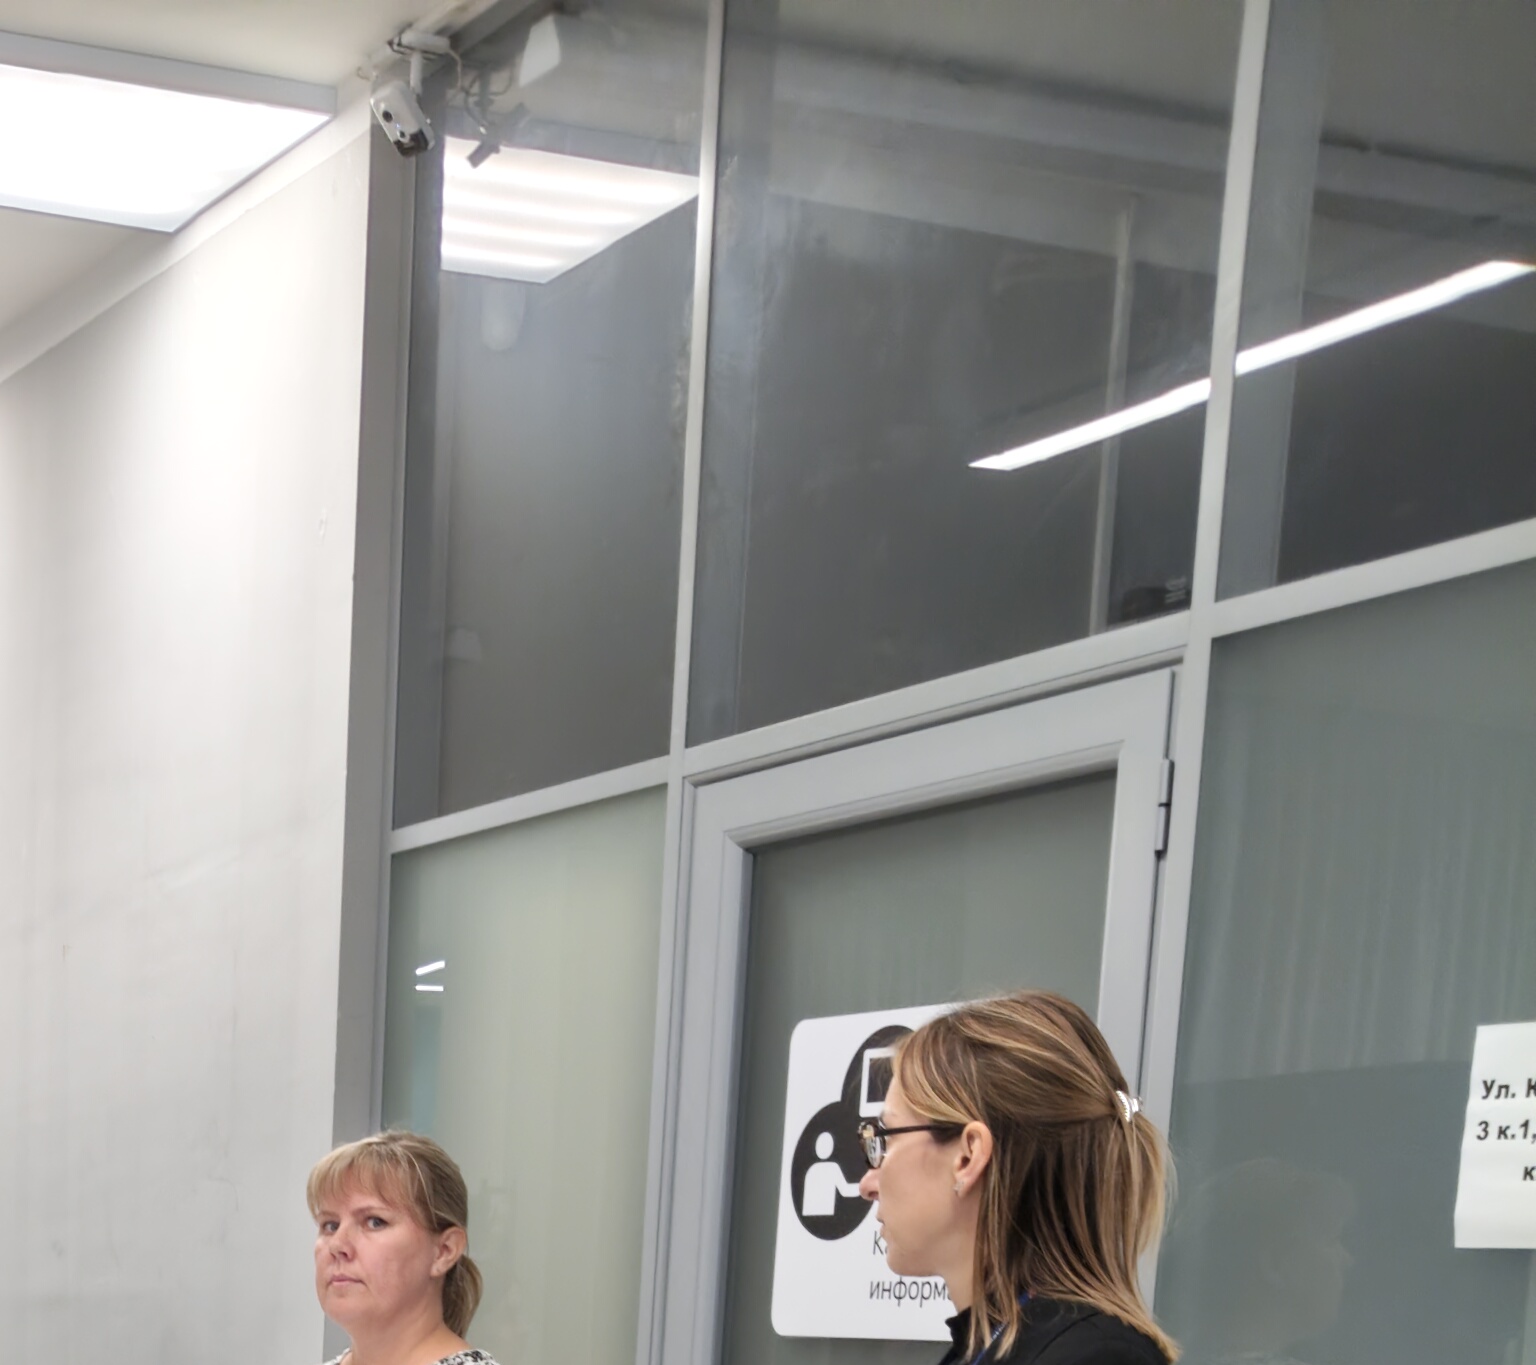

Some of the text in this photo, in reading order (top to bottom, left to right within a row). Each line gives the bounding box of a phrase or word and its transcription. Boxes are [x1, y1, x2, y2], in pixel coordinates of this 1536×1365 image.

[1481, 1079, 1516, 1100] Ул.
[1476, 1120, 1489, 1141] 3
[869, 1276, 953, 1309] информ
